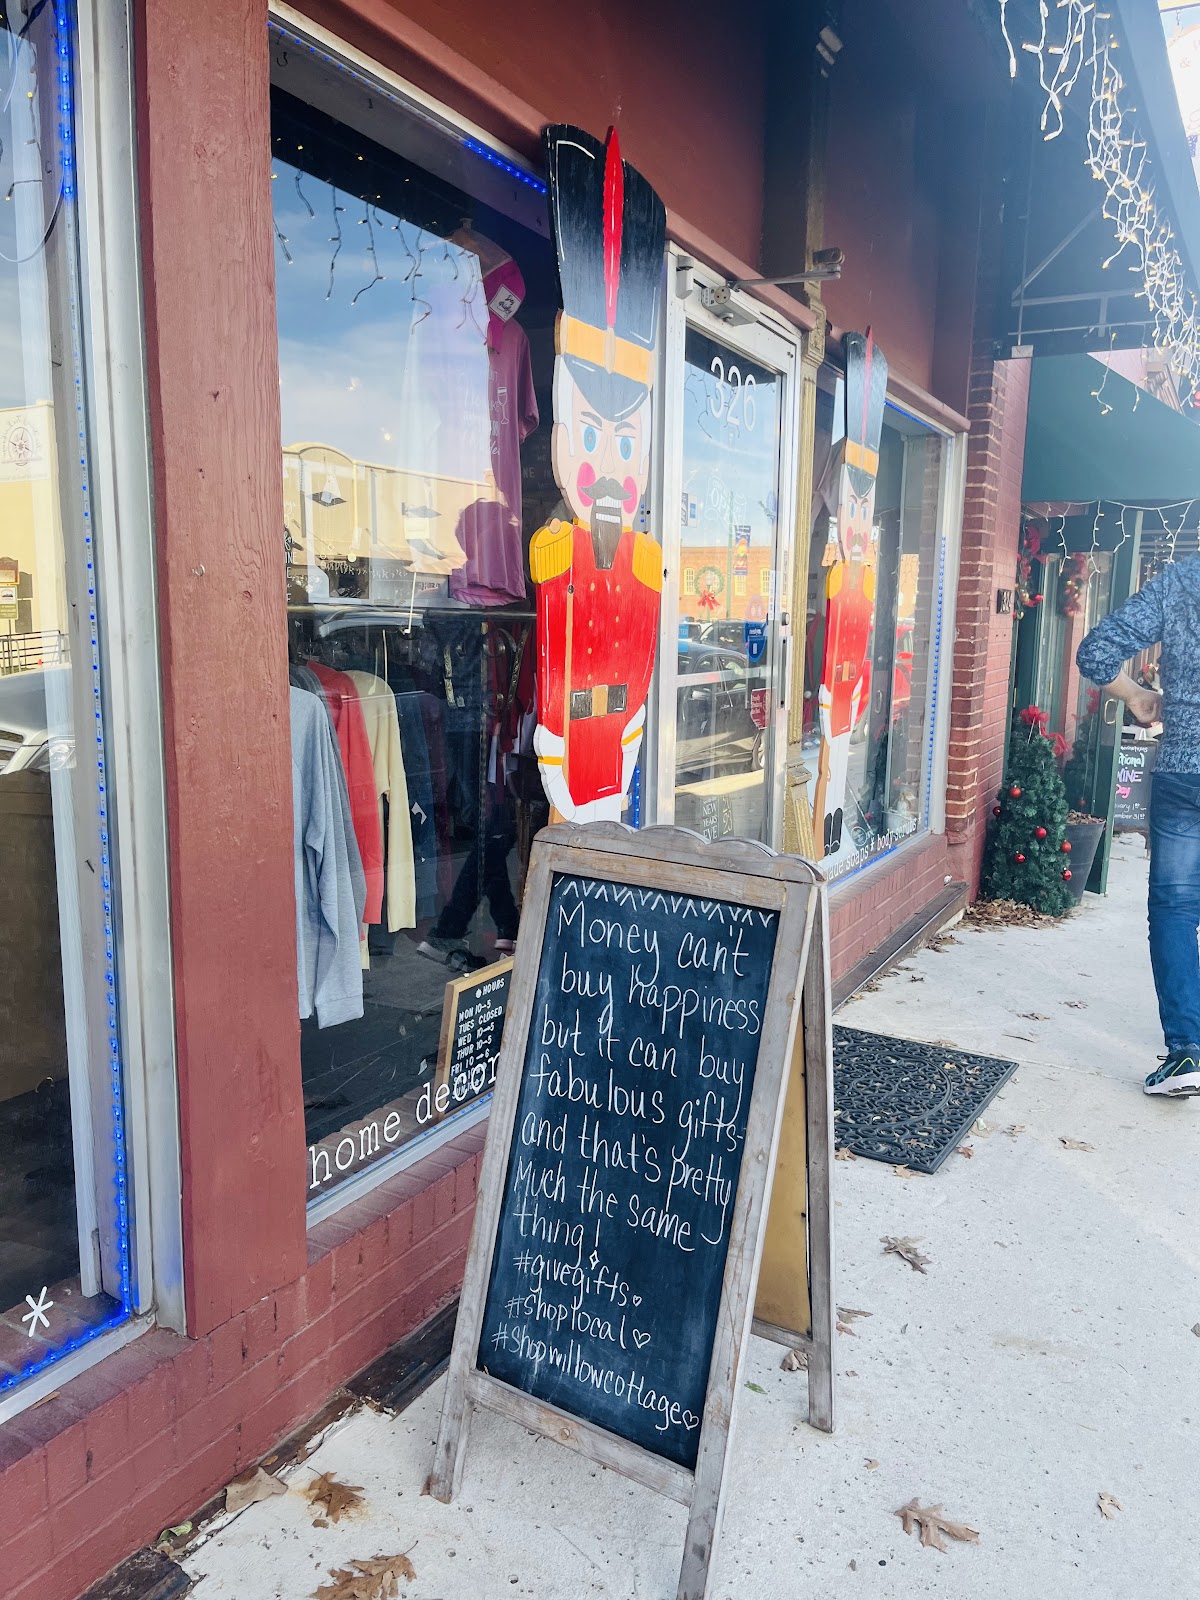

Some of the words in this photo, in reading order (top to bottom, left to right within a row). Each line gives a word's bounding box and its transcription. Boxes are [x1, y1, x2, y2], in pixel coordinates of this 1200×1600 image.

[709, 356, 757, 432] 326
[845, 846, 869, 871] soaps
[557, 900, 660, 988] Money
[677, 924, 749, 977] can't
[458, 1006, 474, 1024] MON
[458, 1019, 475, 1035] TUES
[478, 1005, 503, 1025] CLOSED
[482, 977, 505, 996] HOURS
[560, 952, 614, 1035] buy
[628, 964, 761, 1040] happiness
[450, 1061, 463, 1077] FRI
[456, 1043, 475, 1061] THUR
[457, 1033, 472, 1048] WED
[541, 1003, 586, 1056] but
[597, 1016, 620, 1061] it
[628, 1036, 678, 1078] can
[698, 1034, 745, 1127] buy
[308, 1110, 402, 1190] home
[415, 1052, 501, 1124] decor
[529, 1052, 666, 1124] fabulous
[513, 1155, 567, 1203] Much
[576, 1165, 619, 1218] the
[626, 1193, 696, 1252] same
[521, 1111, 568, 1154] and
[577, 1114, 662, 1183] that's
[664, 1153, 732, 1245] pretty
